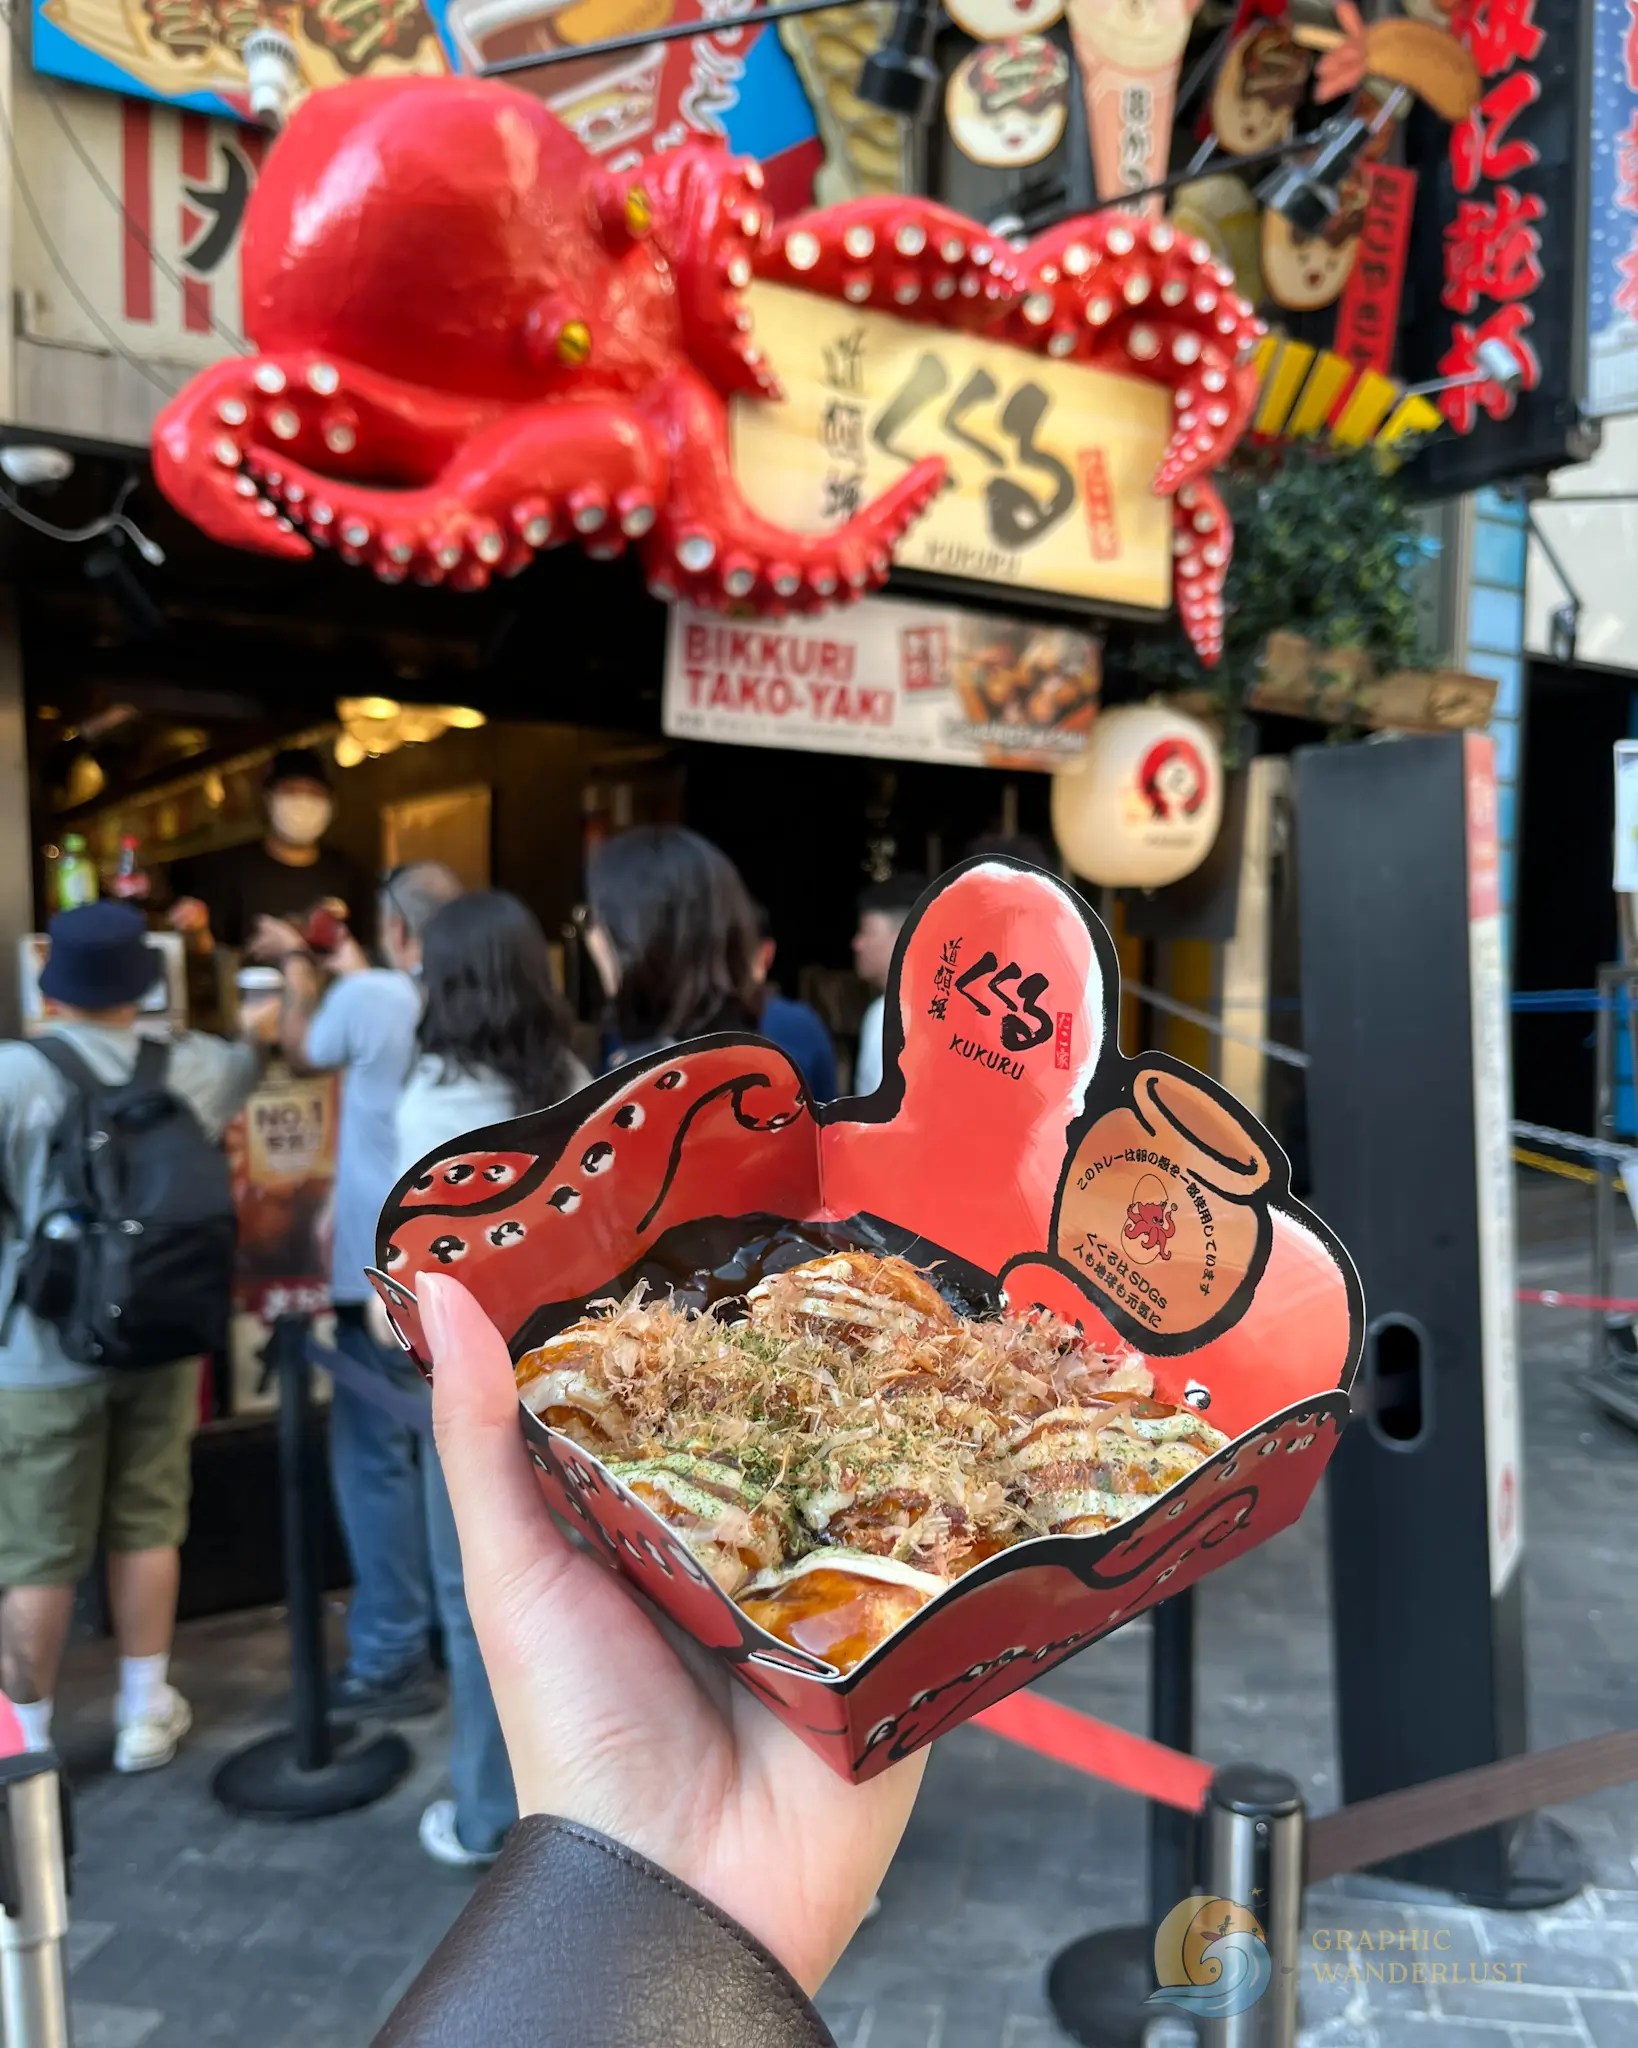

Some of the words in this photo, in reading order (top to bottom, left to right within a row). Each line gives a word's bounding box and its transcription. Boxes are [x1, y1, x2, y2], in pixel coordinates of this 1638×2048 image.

[872, 352, 1076, 550] くくる
[684, 625, 856, 680] BIKKURI
[684, 668, 895, 725] TAKO-YAKI
[928, 937, 963, 1021] 道頓堀
[955, 951, 1054, 1052] くくる
[948, 1033, 1025, 1081] KUKURU
[1073, 1243, 1162, 1329] 人も地球も元気に
